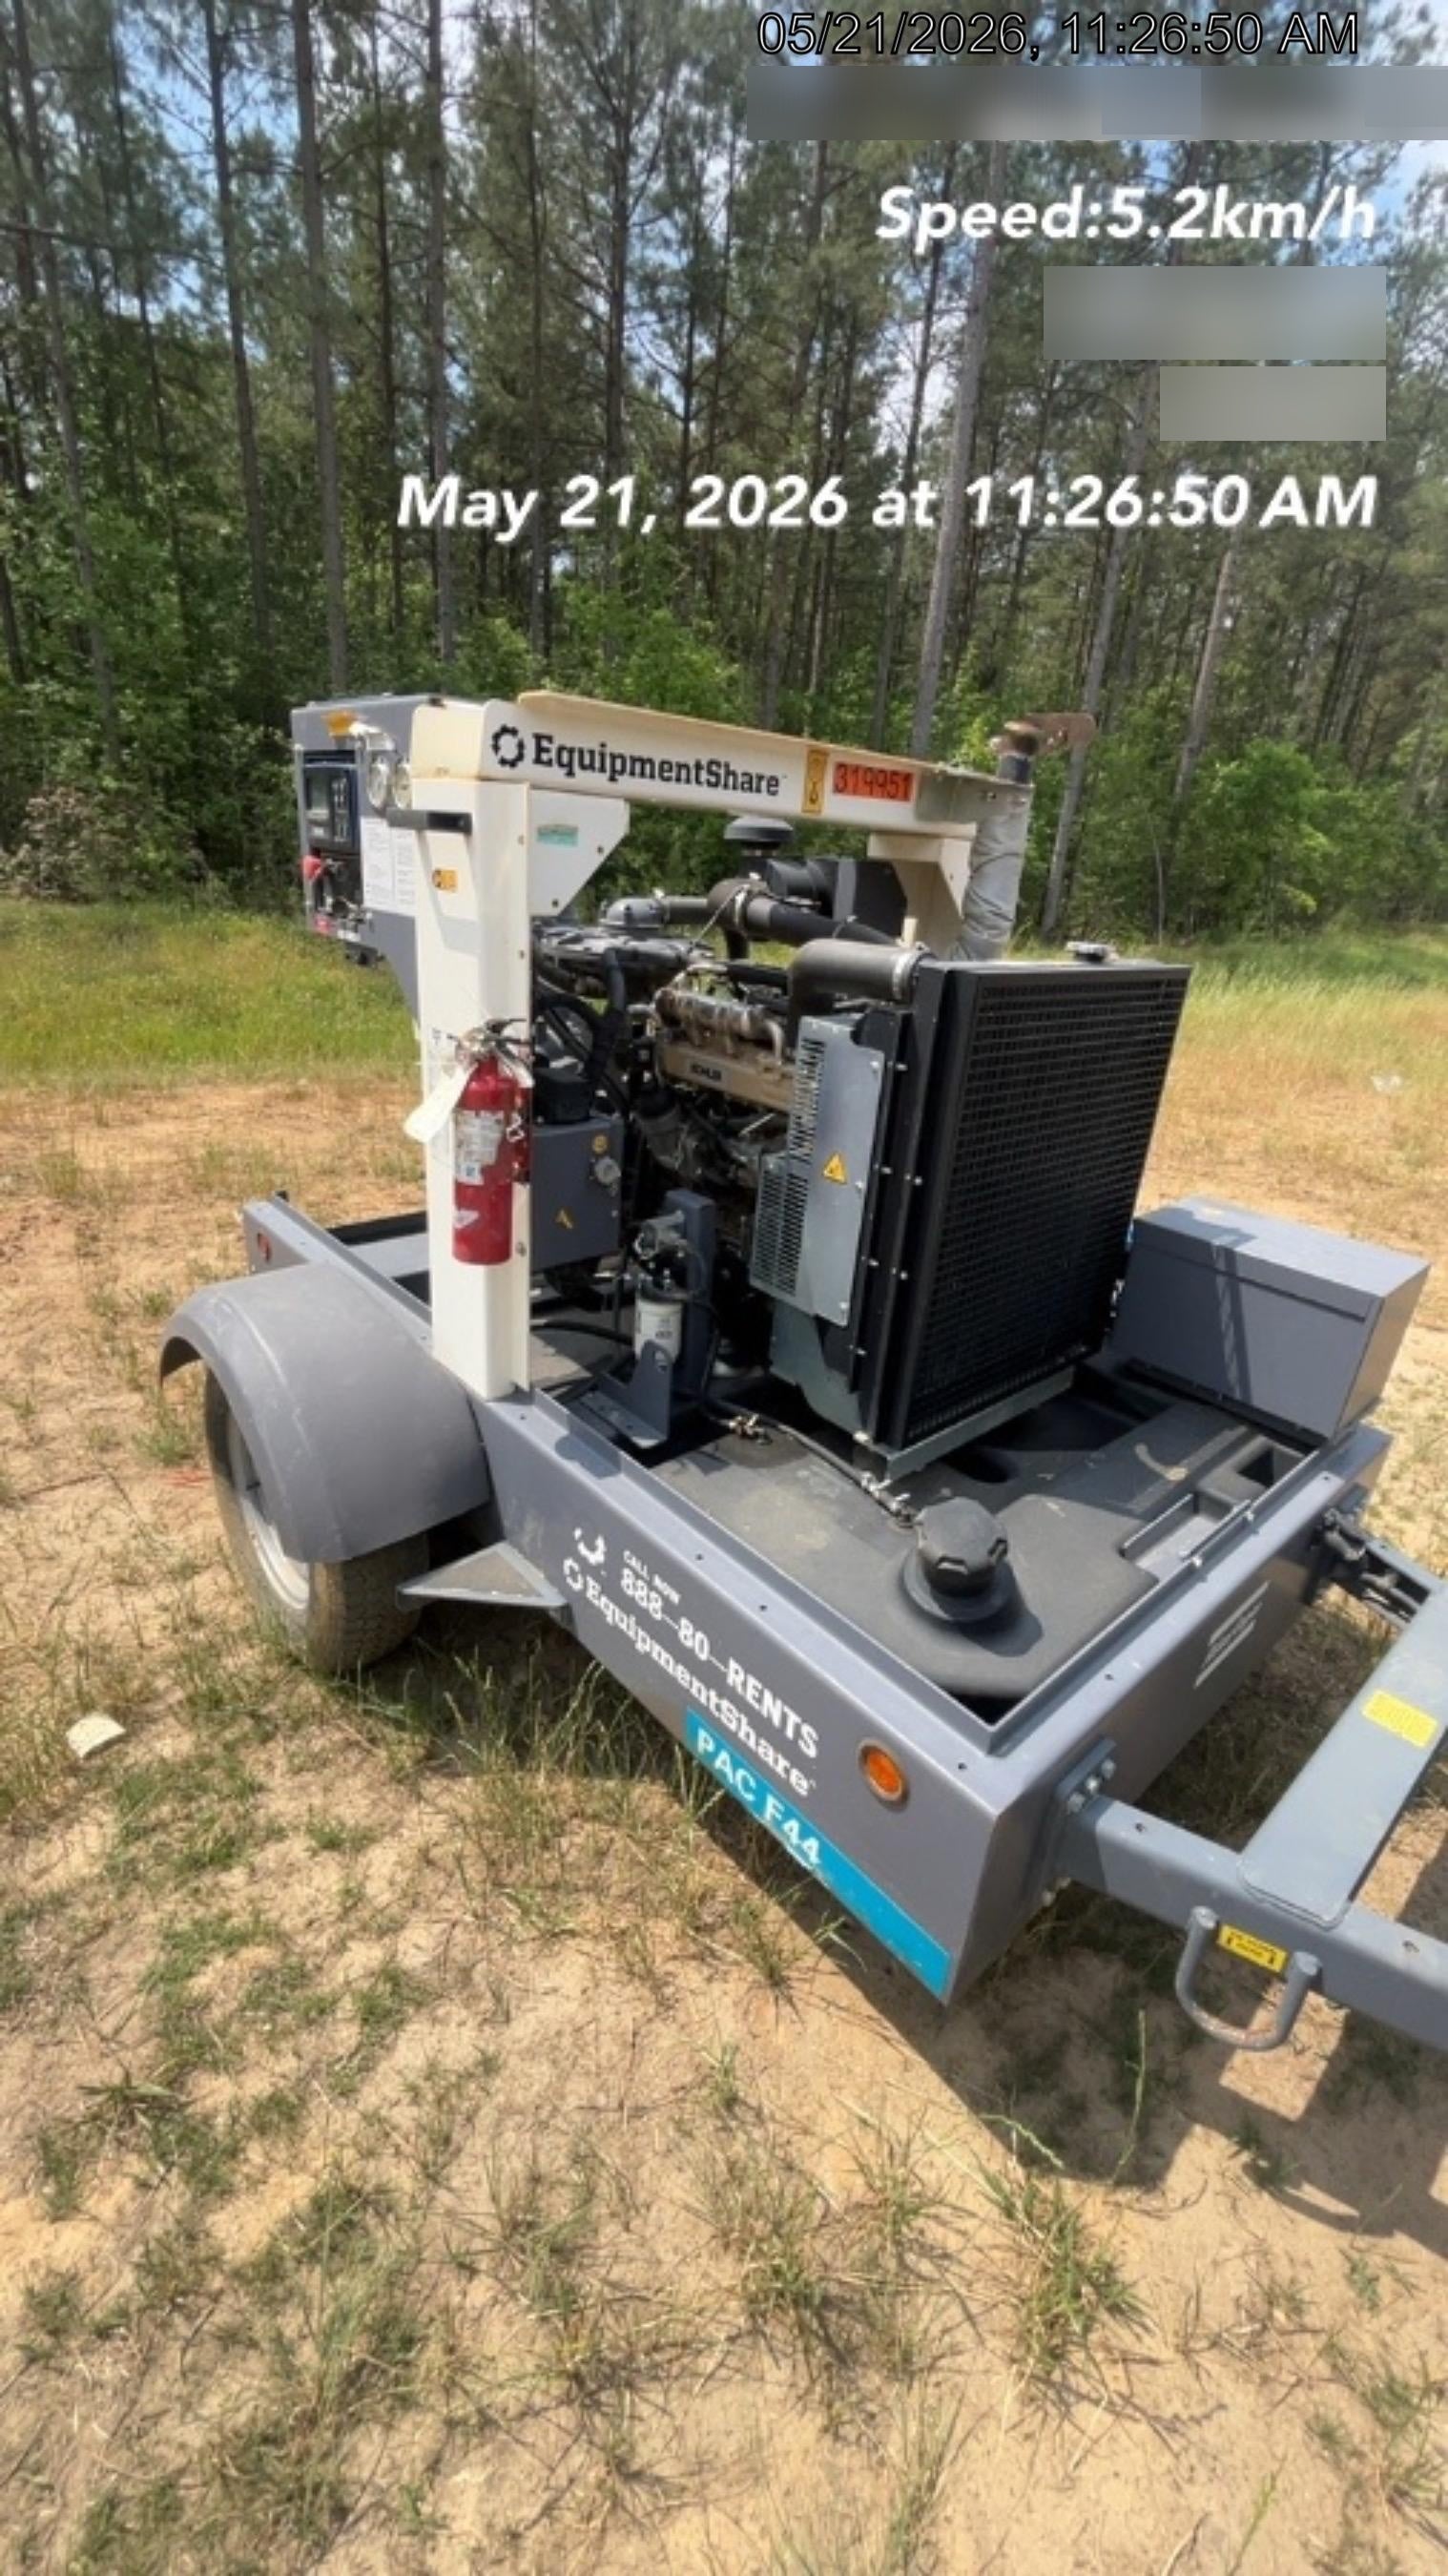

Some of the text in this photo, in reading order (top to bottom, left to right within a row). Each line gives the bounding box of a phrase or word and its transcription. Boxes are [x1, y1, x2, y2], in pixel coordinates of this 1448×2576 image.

[532, 733, 780, 797] EquipmentShare
[586, 1575, 809, 1797] EquipmentShare
[697, 1727, 821, 1865] PAC F44
